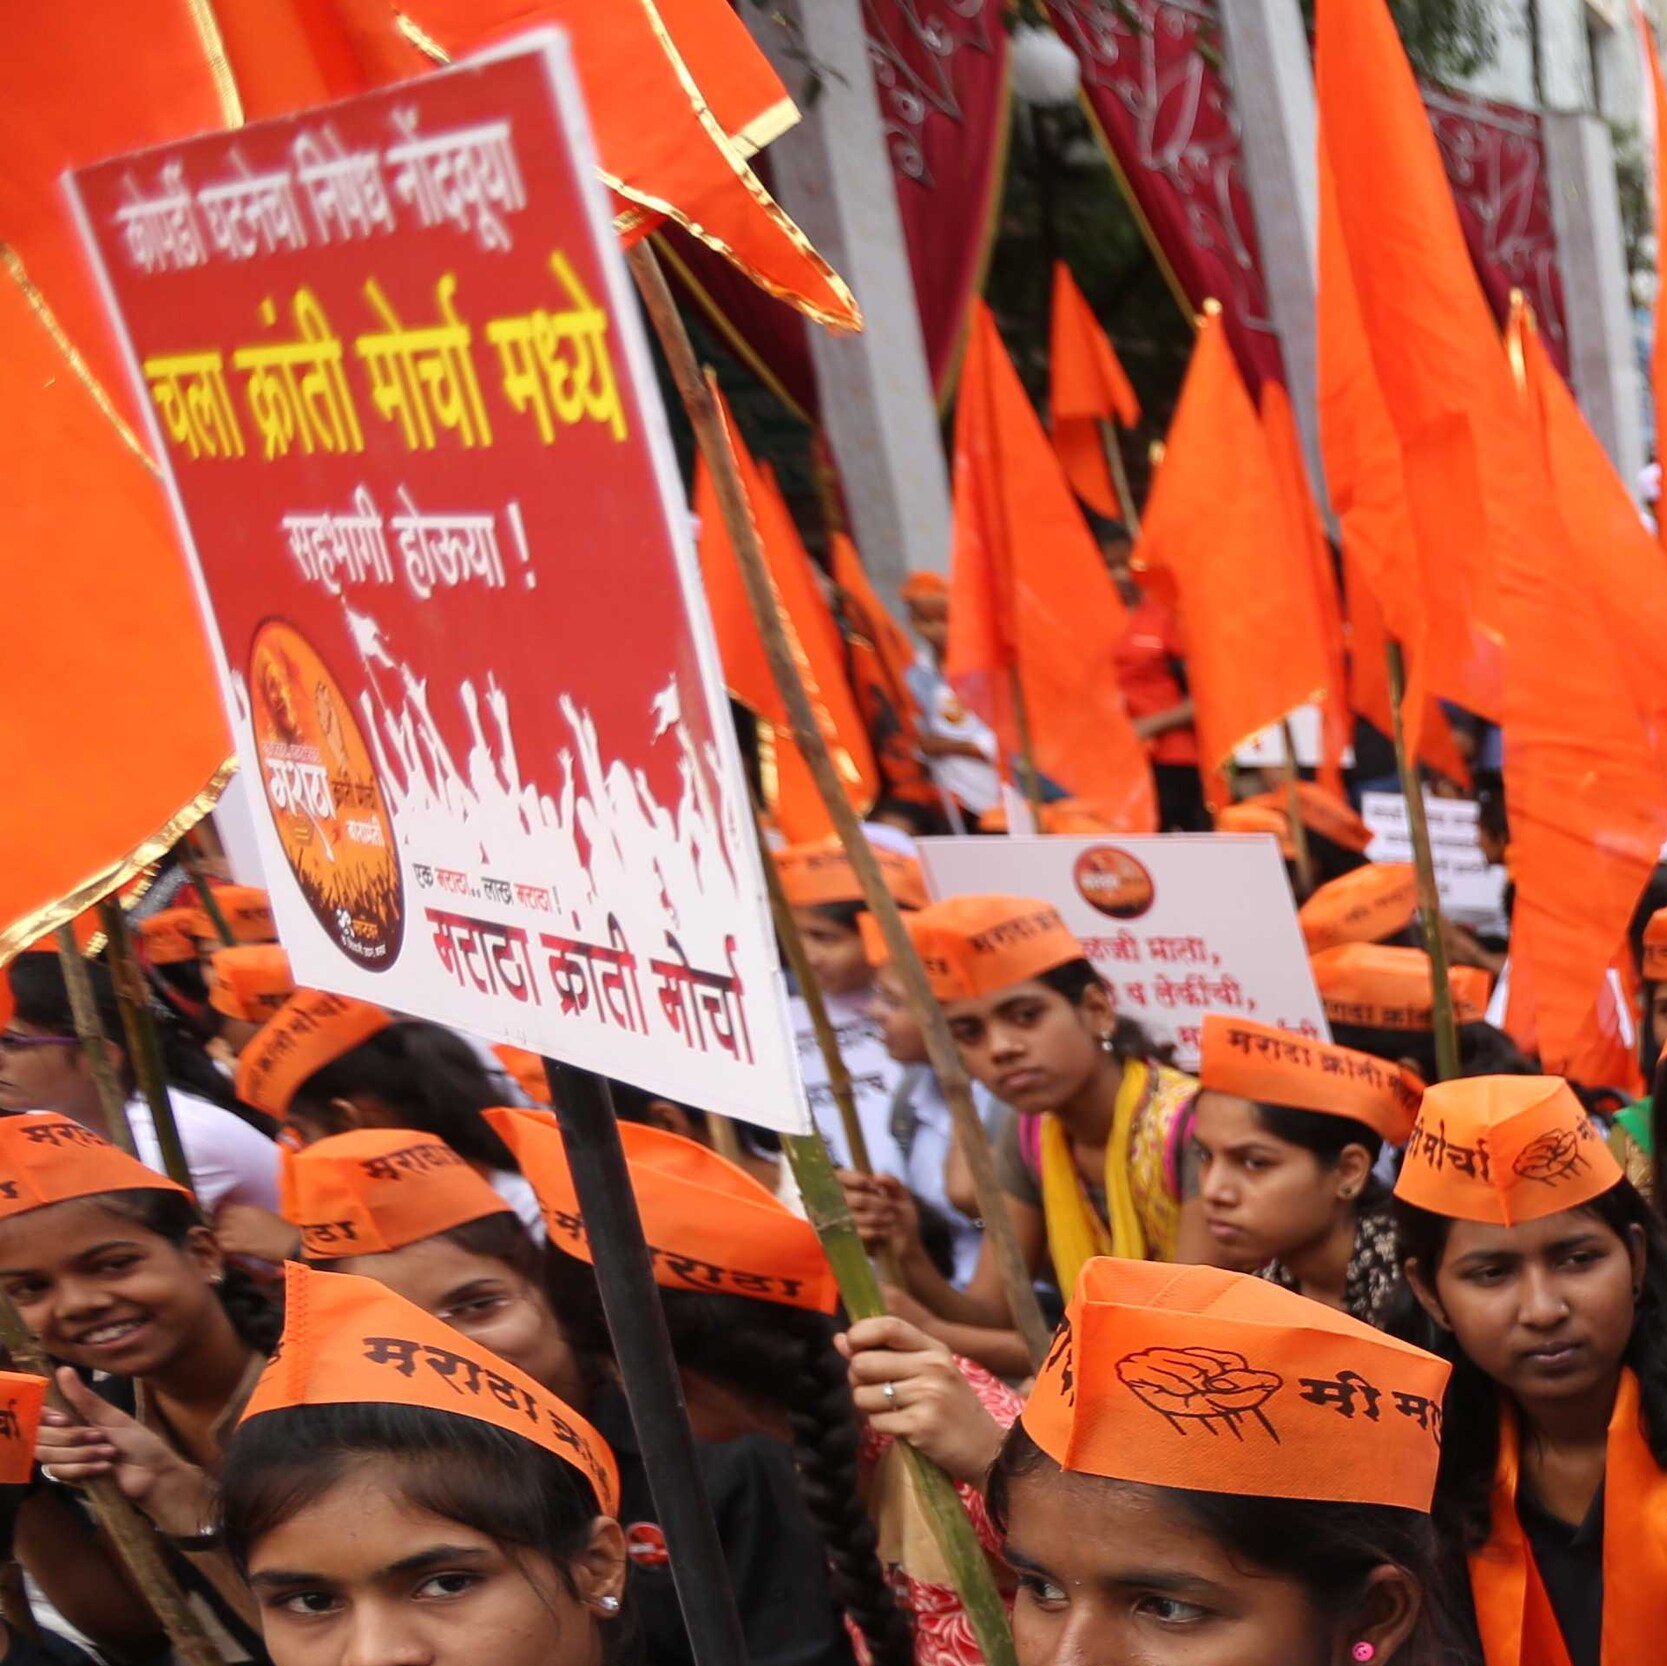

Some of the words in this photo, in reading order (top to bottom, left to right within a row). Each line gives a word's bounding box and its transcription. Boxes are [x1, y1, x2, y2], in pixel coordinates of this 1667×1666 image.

[143, 352, 246, 460] चला
[233, 286, 365, 461] क्रांती
[355, 272, 493, 450] मोर्चा
[486, 250, 629, 445] मध्ये
[282, 484, 395, 594] सहभागी
[391, 486, 506, 598] होऊया
[424, 906, 542, 1006] मराठा
[540, 910, 649, 1036] क्रांती
[649, 930, 756, 1065] मोर्चा
[362, 1336, 540, 1425] मराठा
[1299, 1370, 1382, 1422] मी
